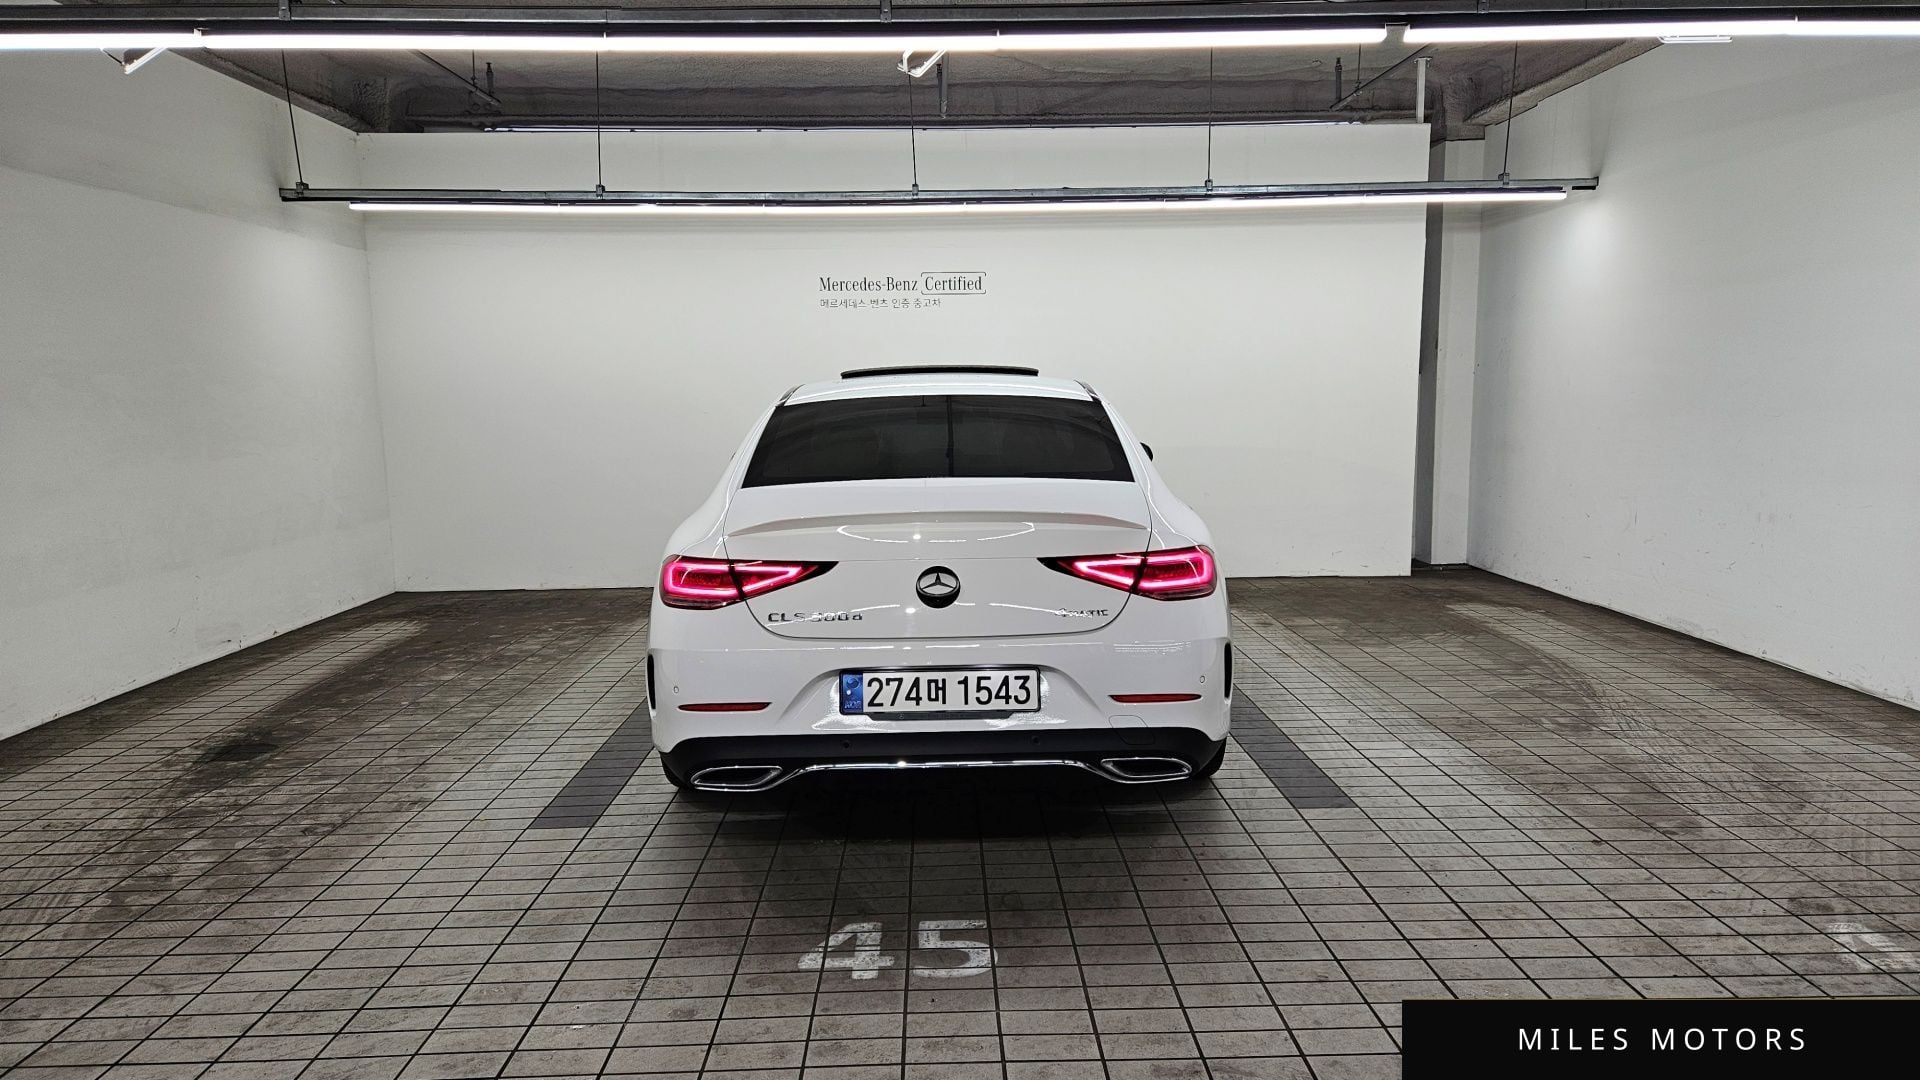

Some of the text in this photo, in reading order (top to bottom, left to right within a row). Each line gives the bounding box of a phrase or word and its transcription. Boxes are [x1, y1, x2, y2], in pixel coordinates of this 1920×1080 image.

[819, 276, 983, 292] Mercedes-Benz Certified
[913, 298, 942, 309] 중고차
[767, 612, 806, 623] CLS
[867, 675, 1031, 708] 274머 1543
[798, 919, 998, 980] 45
